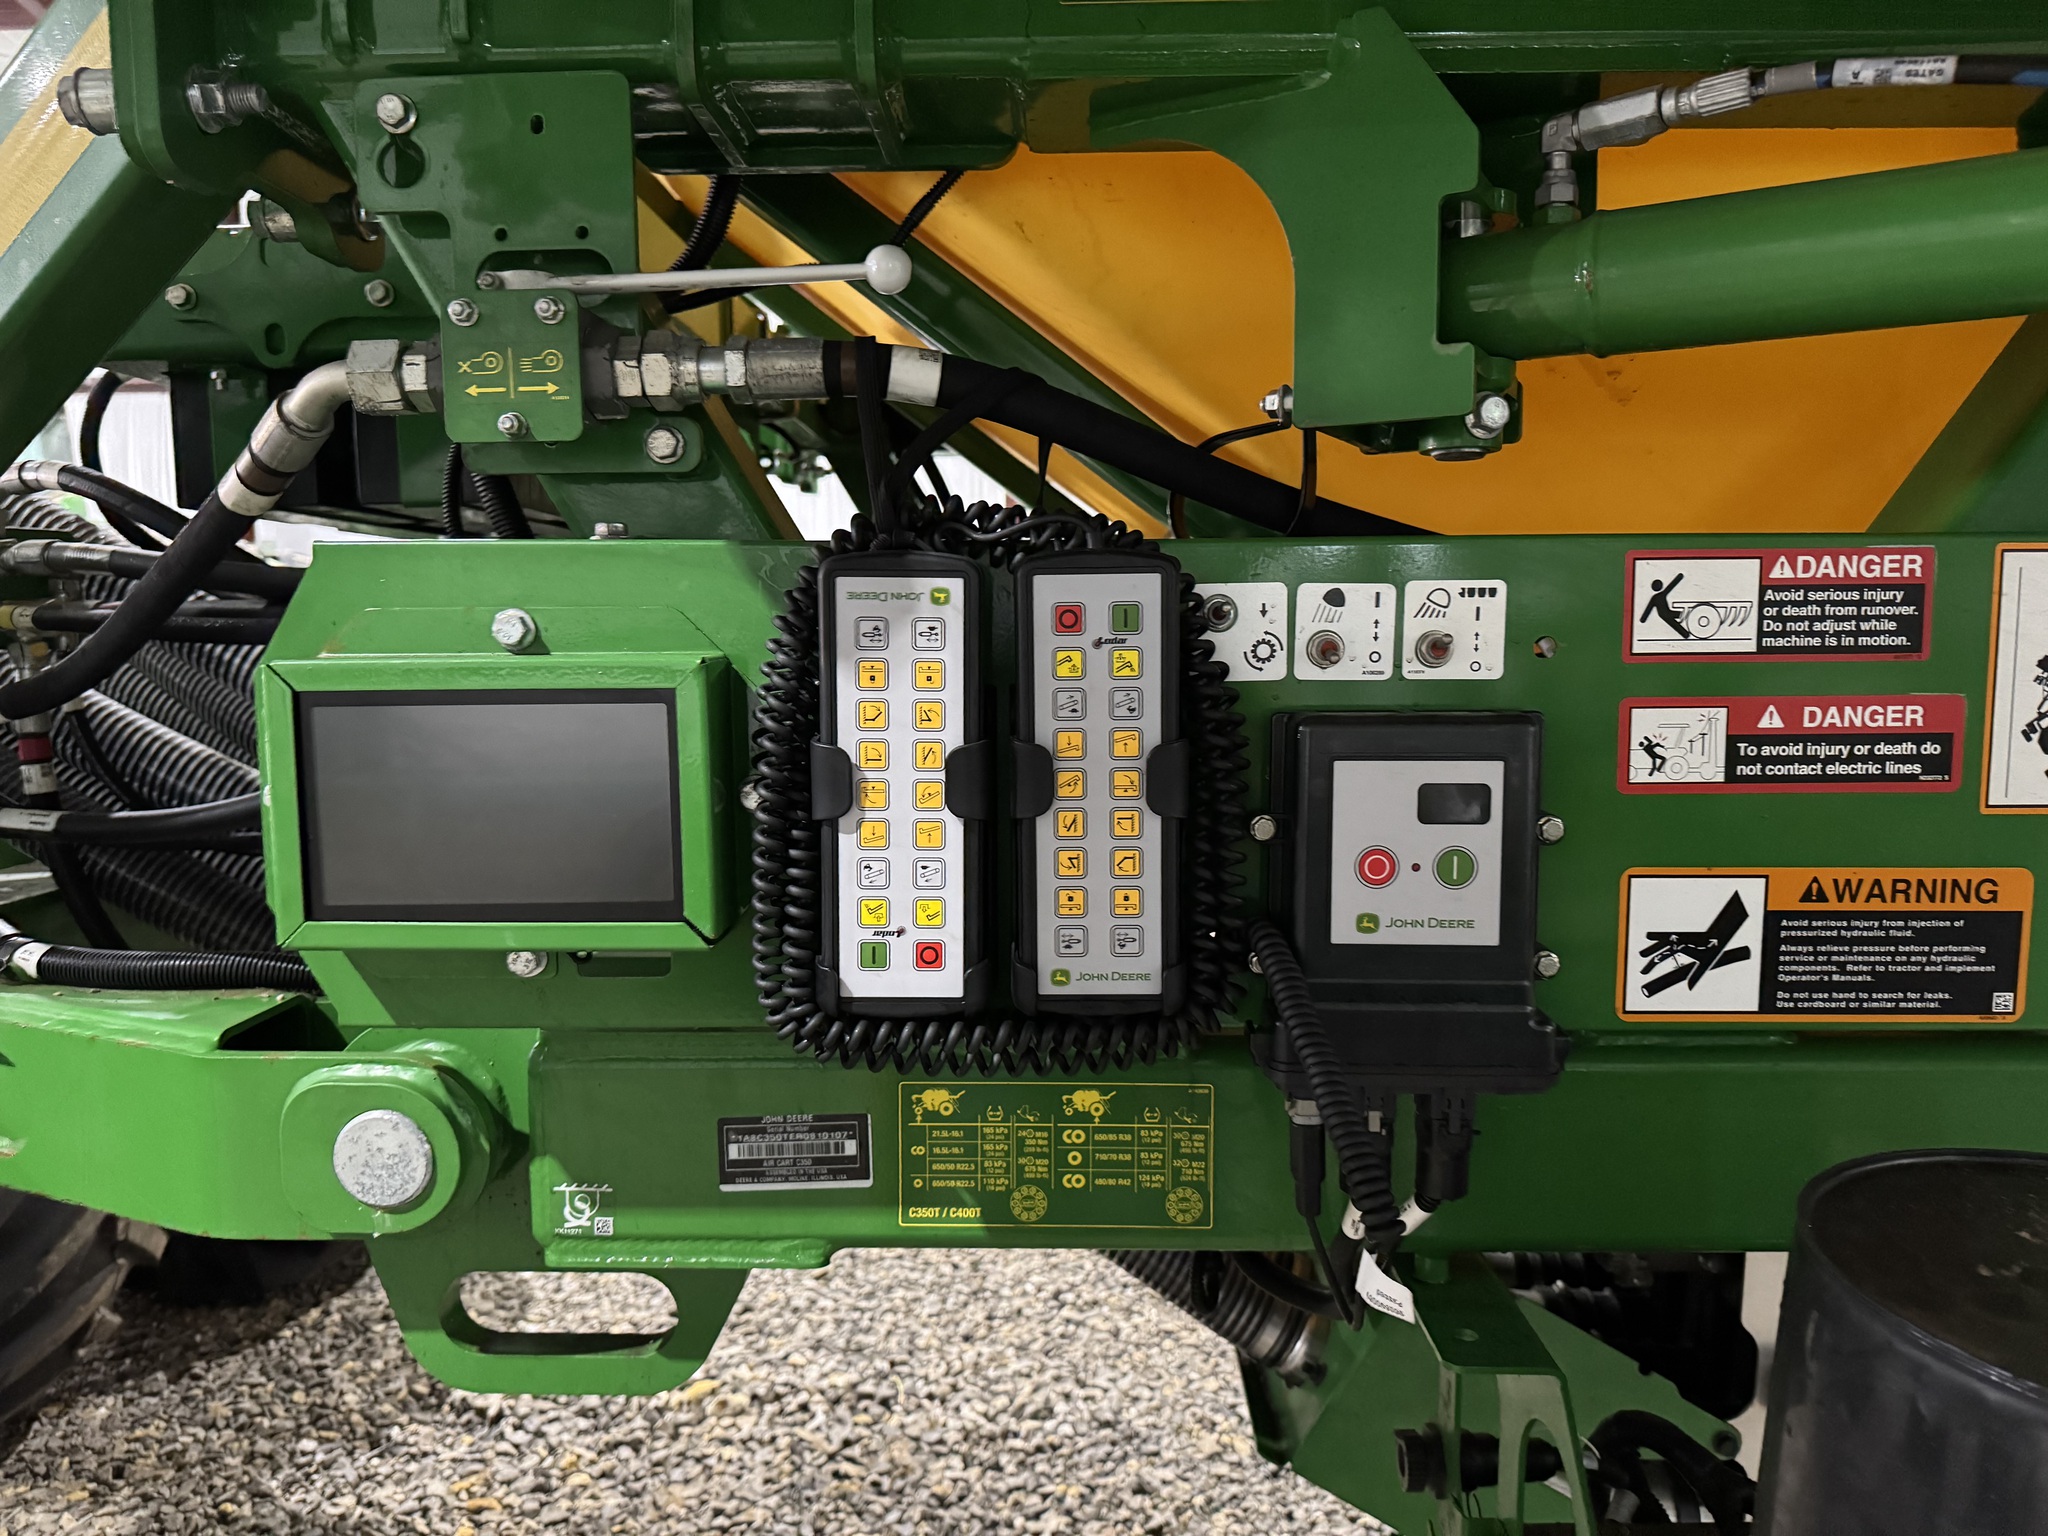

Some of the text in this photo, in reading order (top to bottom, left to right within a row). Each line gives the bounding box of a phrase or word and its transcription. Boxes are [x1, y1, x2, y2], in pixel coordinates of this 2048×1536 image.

[1906, 68, 1944, 77] GATES
[1796, 555, 1922, 578] DANGER
[846, 592, 925, 602] JOHN DEERE
[1764, 589, 1904, 602] Avoid serious injury
[1763, 604, 1918, 616] or death from runover.
[1763, 619, 1897, 633] Do not adjust while
[1762, 634, 1911, 646] machine is in motion.
[1803, 705, 1924, 727] DANGER
[1737, 742, 1941, 758] To avoid injury or death do
[1737, 762, 1922, 775] not contact electric lines
[1832, 878, 1999, 904] WARNING
[1385, 917, 1475, 928] JOHN DEERE
[1851, 920, 1879, 928] injury
[1908, 920, 1951, 928] injection
[1841, 930, 1886, 938] hydraulic
[1932, 945, 1986, 953] performing
[1930, 955, 1976, 963] hydraulic
[1945, 965, 1995, 973] implement
[1076, 972, 1151, 981] JOHN DEERE
[1777, 974, 1829, 982] Operator's
[761, 1114, 813, 1123] JOHN DEERE
[909, 1207, 981, 1218] C350T / C400T
